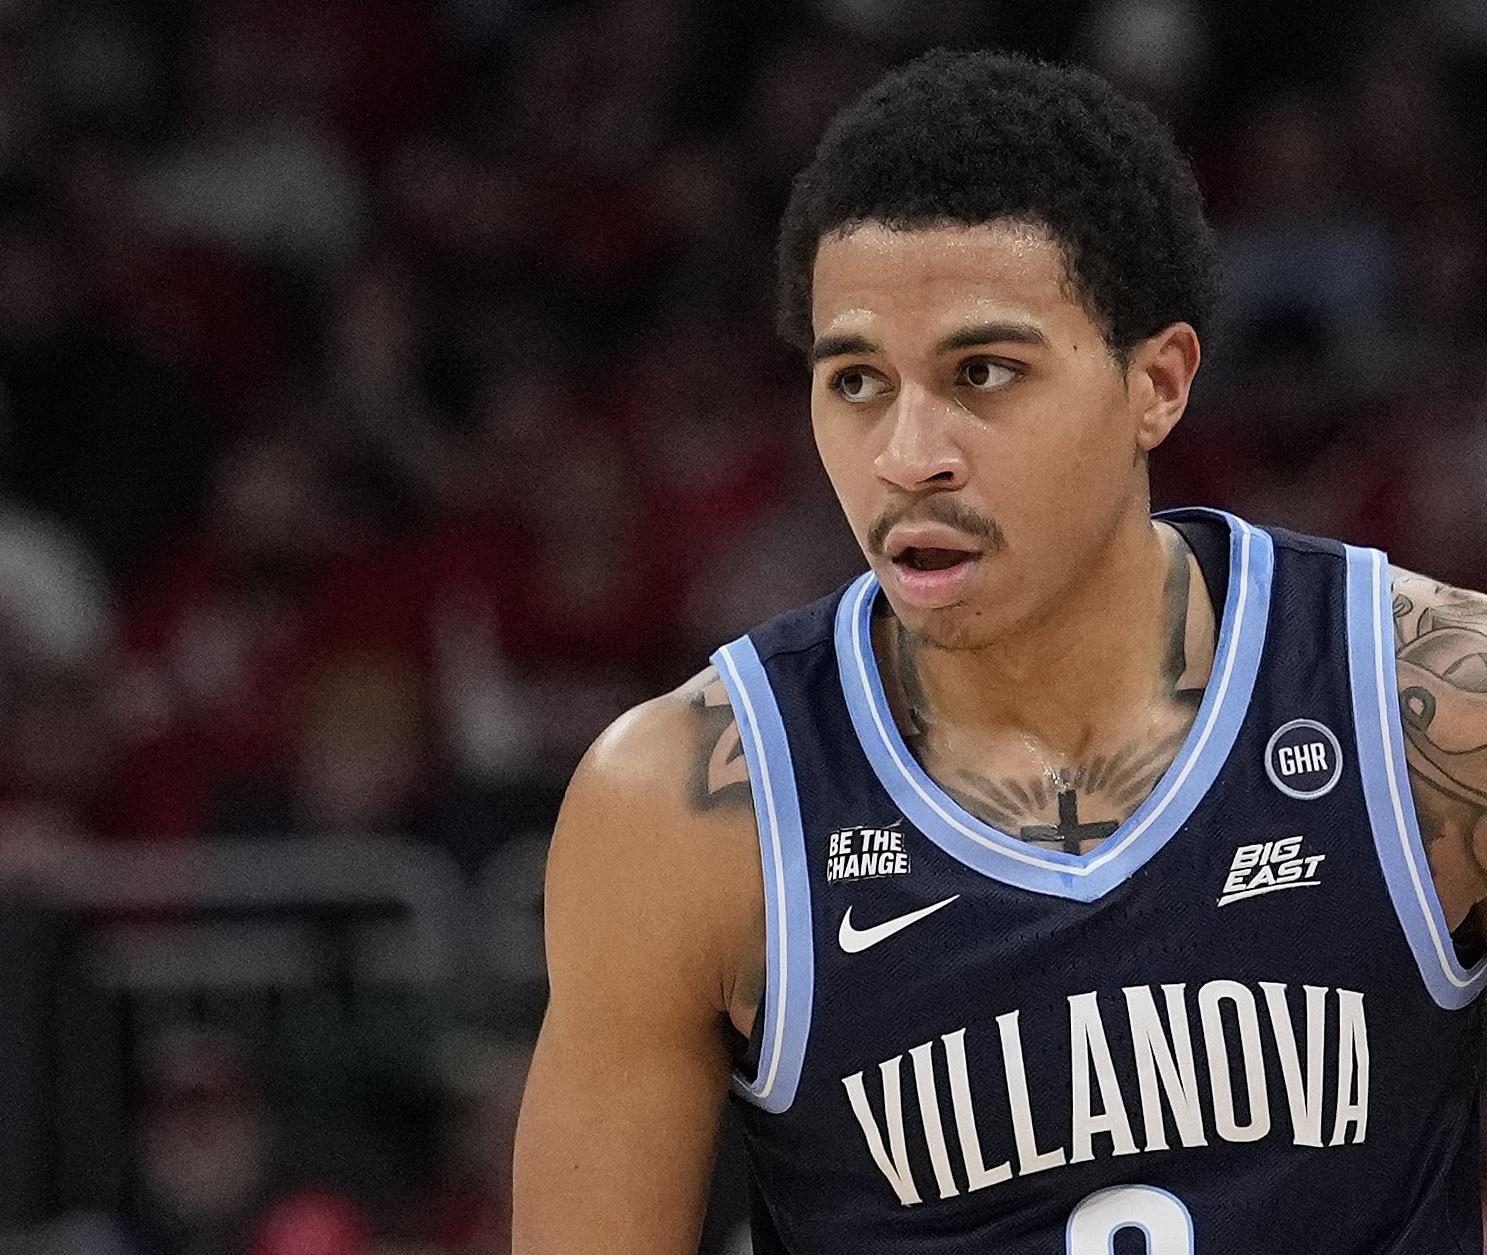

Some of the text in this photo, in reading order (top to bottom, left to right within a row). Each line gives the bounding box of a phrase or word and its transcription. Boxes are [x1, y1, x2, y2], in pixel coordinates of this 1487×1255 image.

[1278, 742, 1328, 776] GHR
[829, 829, 902, 857] BE THE
[1230, 835, 1304, 871] BIG
[826, 852, 908, 882] CHANGE
[1222, 854, 1326, 893] EAST
[842, 979, 1370, 1206] VILLANOVA
